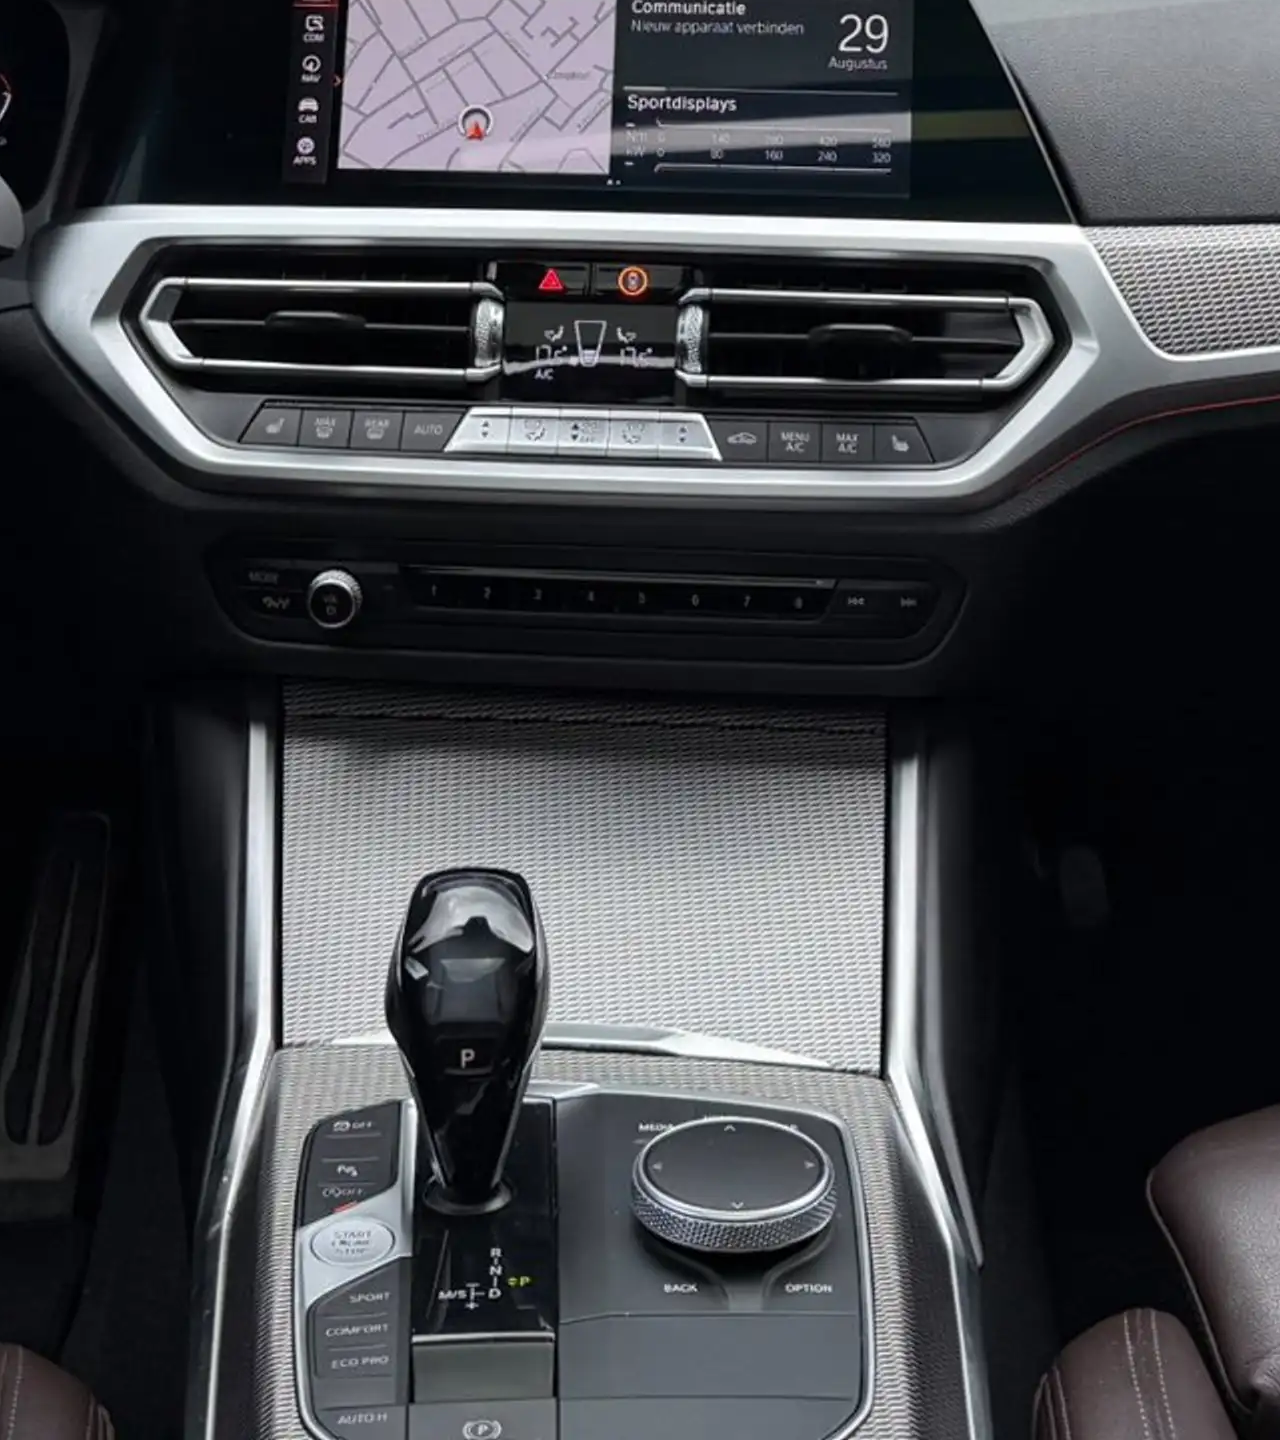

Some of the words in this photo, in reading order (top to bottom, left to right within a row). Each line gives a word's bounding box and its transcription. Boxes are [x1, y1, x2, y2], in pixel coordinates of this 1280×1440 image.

[631, 0, 747, 16] Communicatie
[631, 20, 671, 33] Nieuw
[674, 20, 734, 35] apparaat
[736, 19, 804, 35] verbinden
[837, 14, 890, 53] 29
[828, 56, 888, 72] Augustus
[627, 95, 737, 112] Sportdisplays
[534, 368, 554, 381] A/C
[413, 423, 443, 436] AUTO
[780, 431, 810, 442] MENU
[836, 433, 859, 444] MAX
[785, 442, 805, 453] A/C
[837, 443, 858, 453] A/C
[460, 1049, 475, 1069] P
[489, 1265, 502, 1276] N
[519, 1276, 531, 1287] P
[663, 1283, 698, 1293] BACK
[784, 1283, 832, 1293] OPTION
[349, 1291, 391, 1304] SPORT
[488, 1288, 502, 1299] D
[325, 1323, 389, 1337] COMFORT
[331, 1357, 358, 1369] ECO
[361, 1356, 390, 1366] PRO
[337, 1413, 374, 1425] AUTO
[376, 1412, 388, 1423] H
